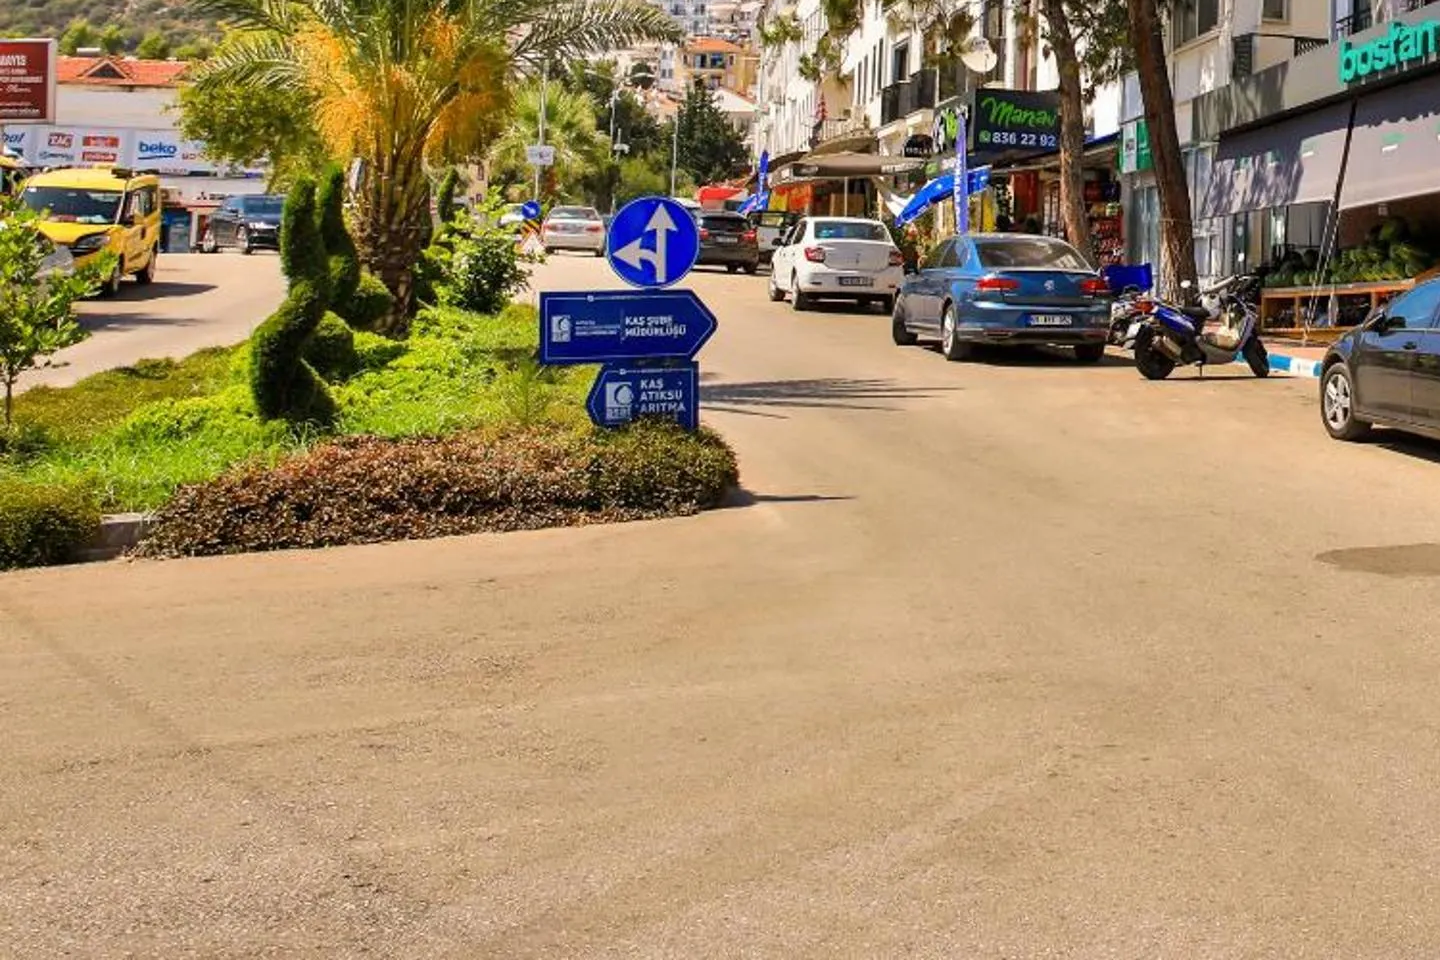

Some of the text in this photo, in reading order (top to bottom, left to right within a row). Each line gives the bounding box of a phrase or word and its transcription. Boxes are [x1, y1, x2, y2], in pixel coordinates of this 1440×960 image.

[1338, 19, 1440, 86] bostan
[1020, 133, 1037, 146] 22
[138, 141, 177, 155] beko
